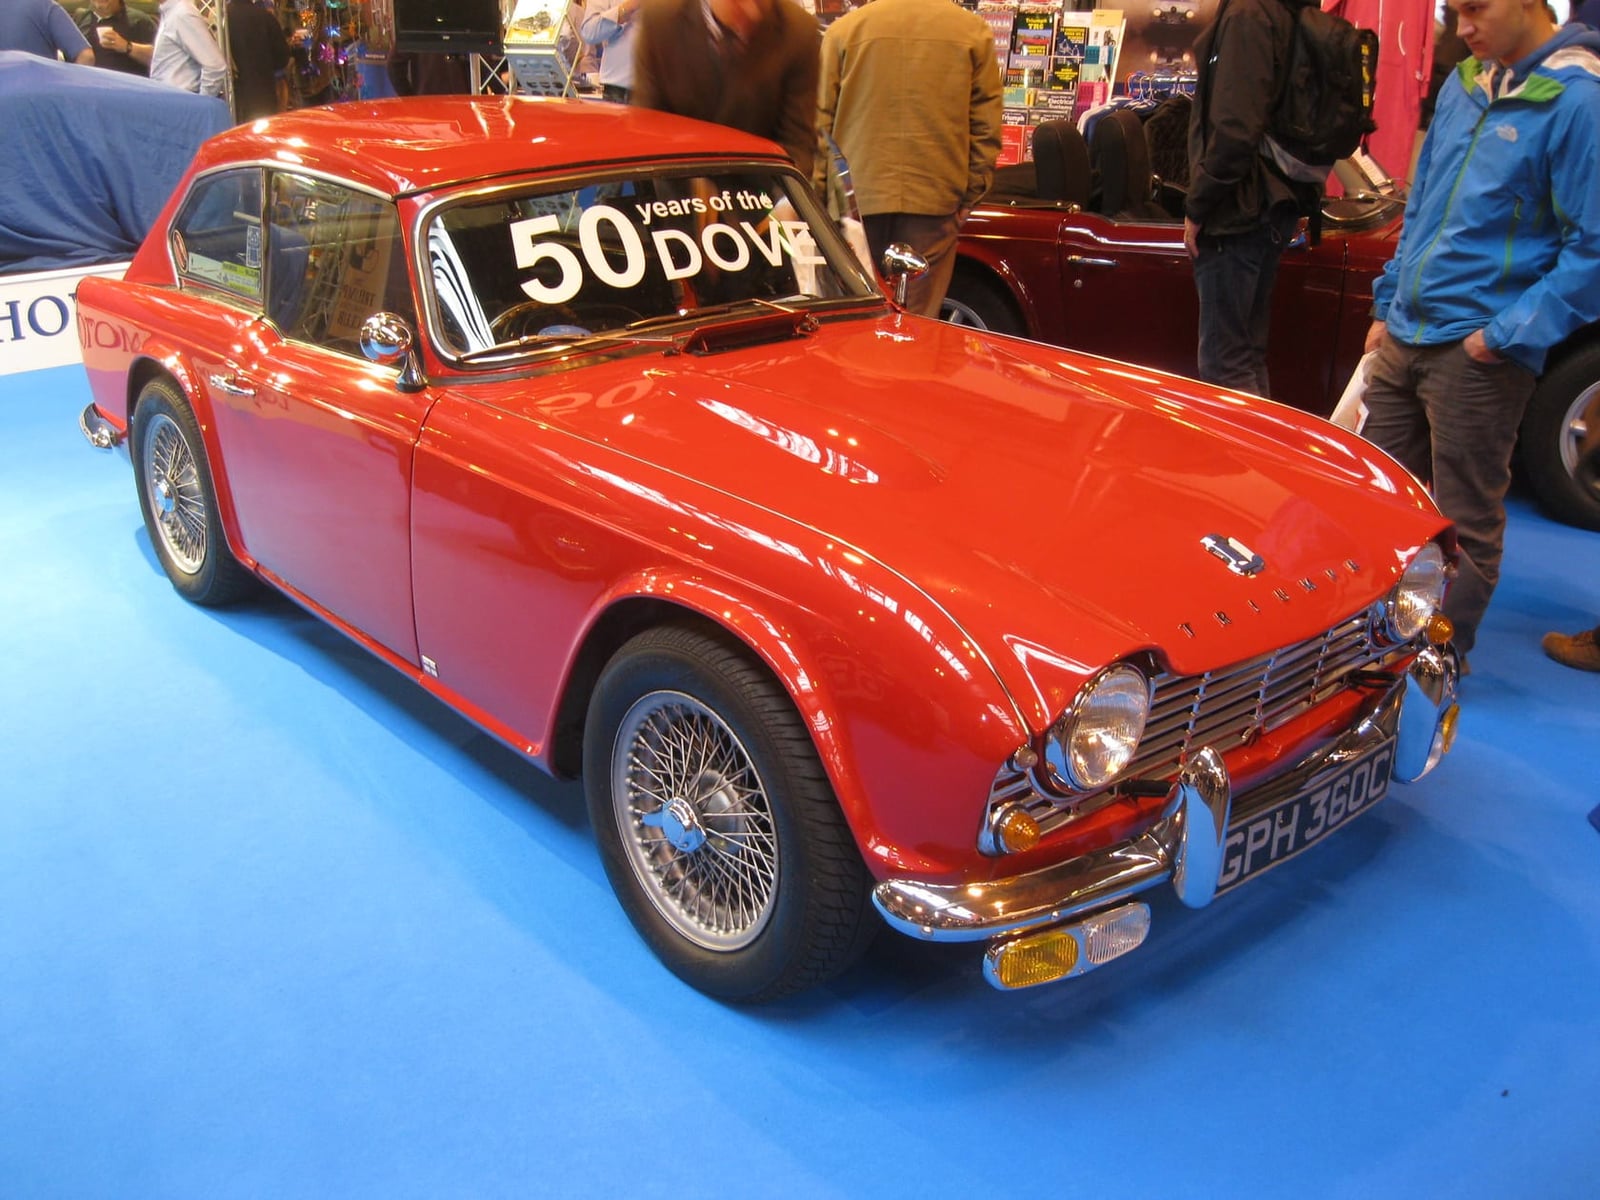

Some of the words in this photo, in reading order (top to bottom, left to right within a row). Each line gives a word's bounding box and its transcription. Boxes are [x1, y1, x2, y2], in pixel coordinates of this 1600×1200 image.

[635, 197, 704, 225] years
[708, 191, 734, 212] of
[736, 190, 774, 211] the
[510, 204, 646, 304] 50
[651, 220, 827, 281] DOVE
[0, 292, 77, 344] HO
[1177, 558, 1360, 639] TRIUMPH
[1217, 804, 1301, 887] GPH
[1304, 750, 1390, 841] 360C
